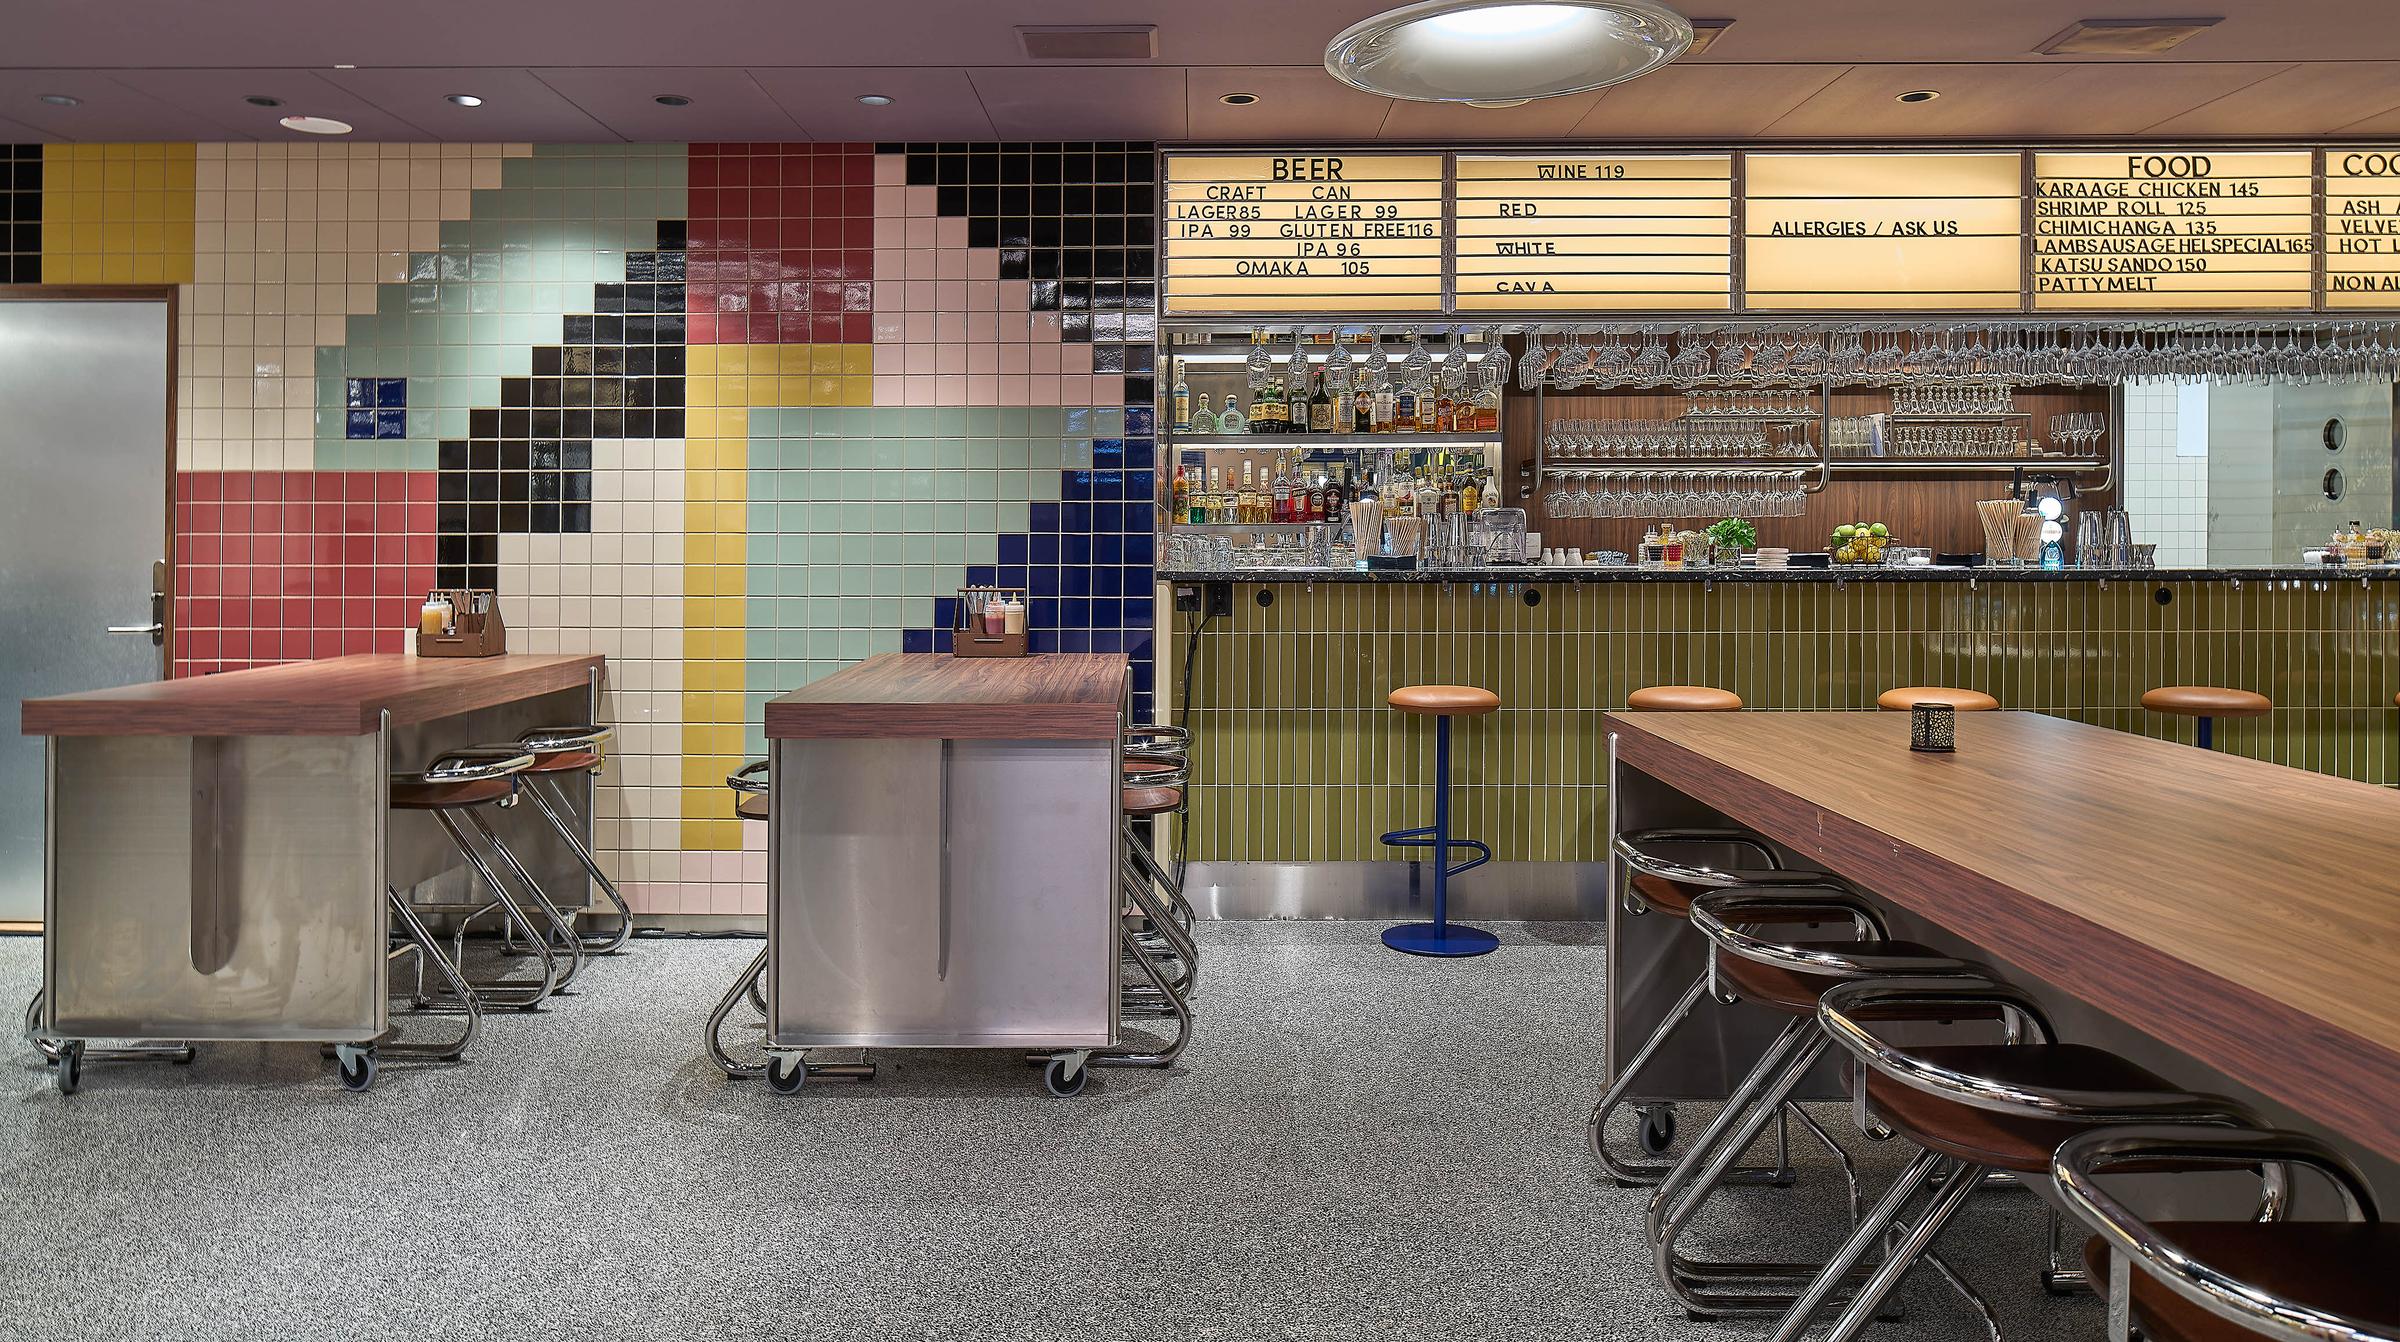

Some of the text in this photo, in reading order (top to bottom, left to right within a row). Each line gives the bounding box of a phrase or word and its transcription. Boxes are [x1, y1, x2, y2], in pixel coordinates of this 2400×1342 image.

[1273, 158, 1343, 181] BEER
[1537, 165, 1625, 179] WINE 119
[2128, 156, 2212, 178] FOOD
[1206, 185, 1351, 200] CRAFT CAN
[2036, 182, 2259, 198] KARAAGE CHICKEN 145
[1295, 204, 1362, 219] LAGER
[1375, 205, 1398, 219] 99
[1499, 203, 1537, 217] RED
[2038, 201, 2207, 216] SHRIMP ROLL 125
[2343, 200, 2381, 215] ASH
[1181, 223, 1214, 238] IPA
[1229, 224, 1251, 238] 99
[1280, 222, 1353, 238] GLUTEN
[1771, 220, 1958, 236] ALLERGIES / ASK US
[2038, 220, 2217, 236] CHIMICHANGA 135
[2340, 219, 2400, 235] VELVE
[1297, 242, 1361, 257] IPA 96
[1496, 242, 1556, 255] WHITE
[2340, 238, 2382, 253] HOT
[1236, 260, 1370, 276] OMAKA 105
[2041, 257, 2207, 273] KATSU SANDO 150
[1496, 281, 1555, 293] CAVA
[2333, 275, 2376, 291] NON
